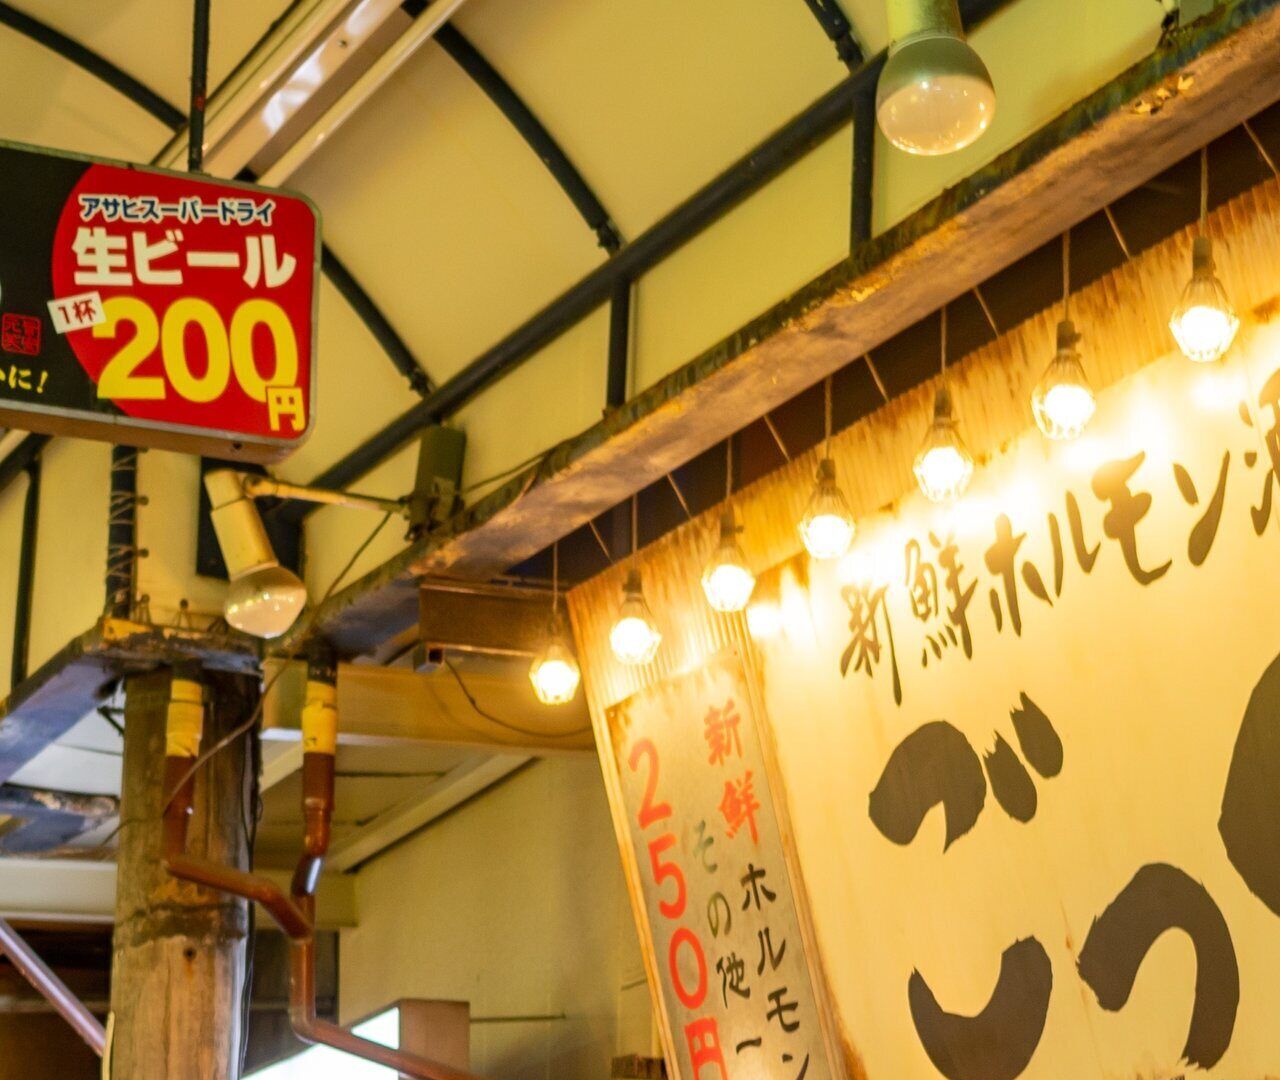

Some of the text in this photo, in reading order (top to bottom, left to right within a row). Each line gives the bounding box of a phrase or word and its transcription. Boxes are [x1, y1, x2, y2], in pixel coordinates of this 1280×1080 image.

[79, 196, 276, 226] アサヒスーパードライ
[72, 227, 297, 290] 生ビール
